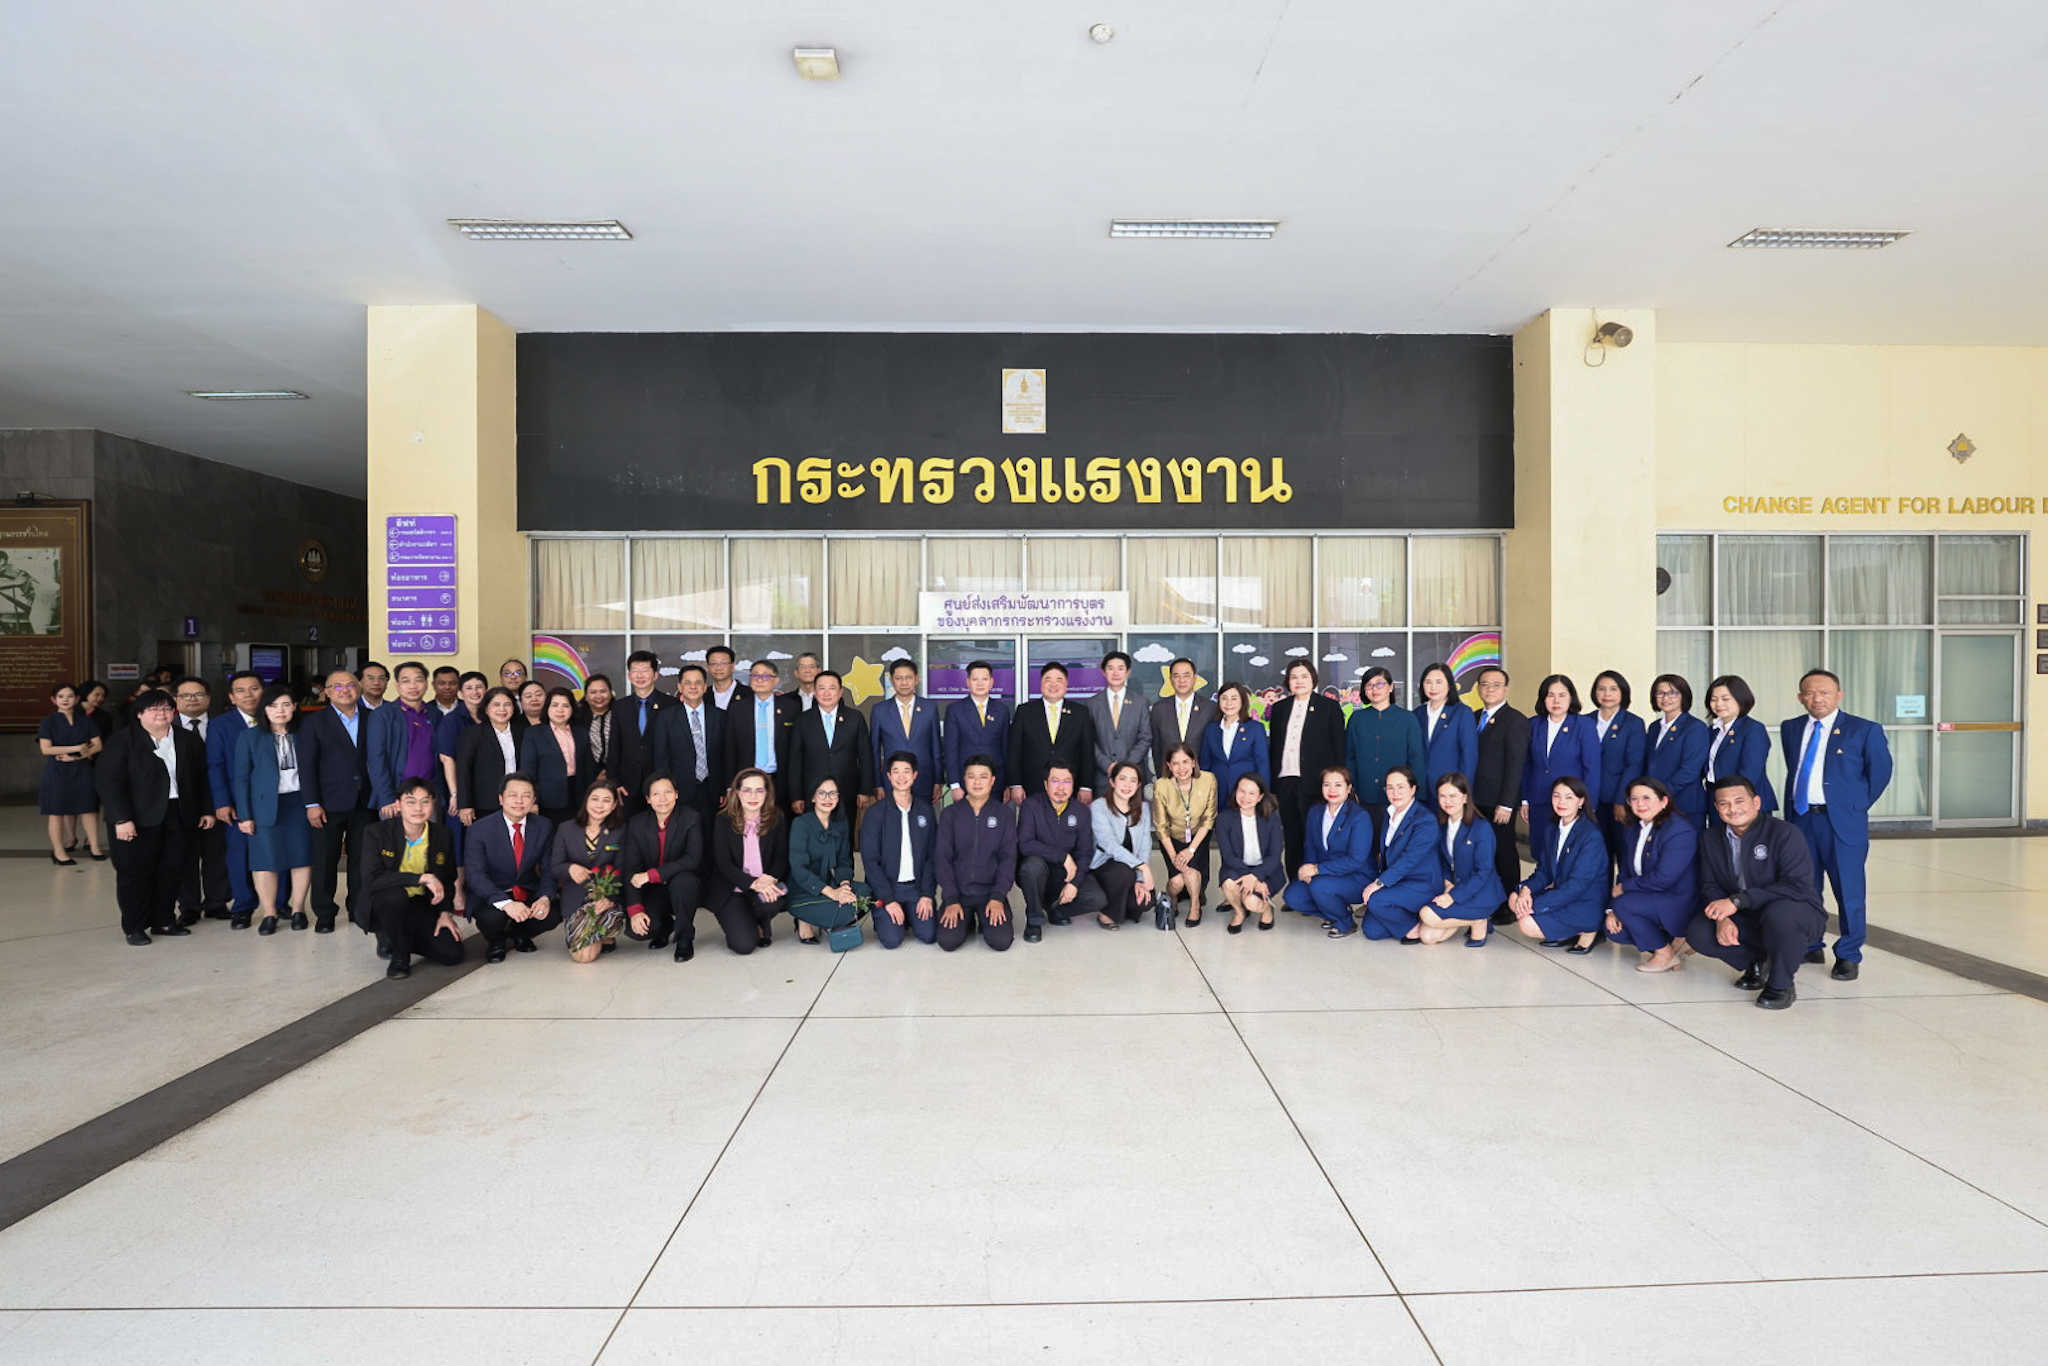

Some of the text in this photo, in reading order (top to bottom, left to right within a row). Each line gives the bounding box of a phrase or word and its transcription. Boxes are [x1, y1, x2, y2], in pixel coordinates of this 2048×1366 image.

[752, 456, 1293, 504] กระทรวงแรงงาน
[1723, 496, 1813, 514] CHANGE
[1820, 496, 1892, 514] AGENT
[1898, 496, 1941, 514] FOR
[1947, 496, 2035, 514] LABOUR
[943, 594, 1106, 616] ศูนย์ส่งเสริมพัฒนาการบุตร
[187, 619, 196, 635] 1
[937, 614, 1114, 632] ของบุคลากรกระทรวงแรงงาน
[309, 627, 317, 641] 2
